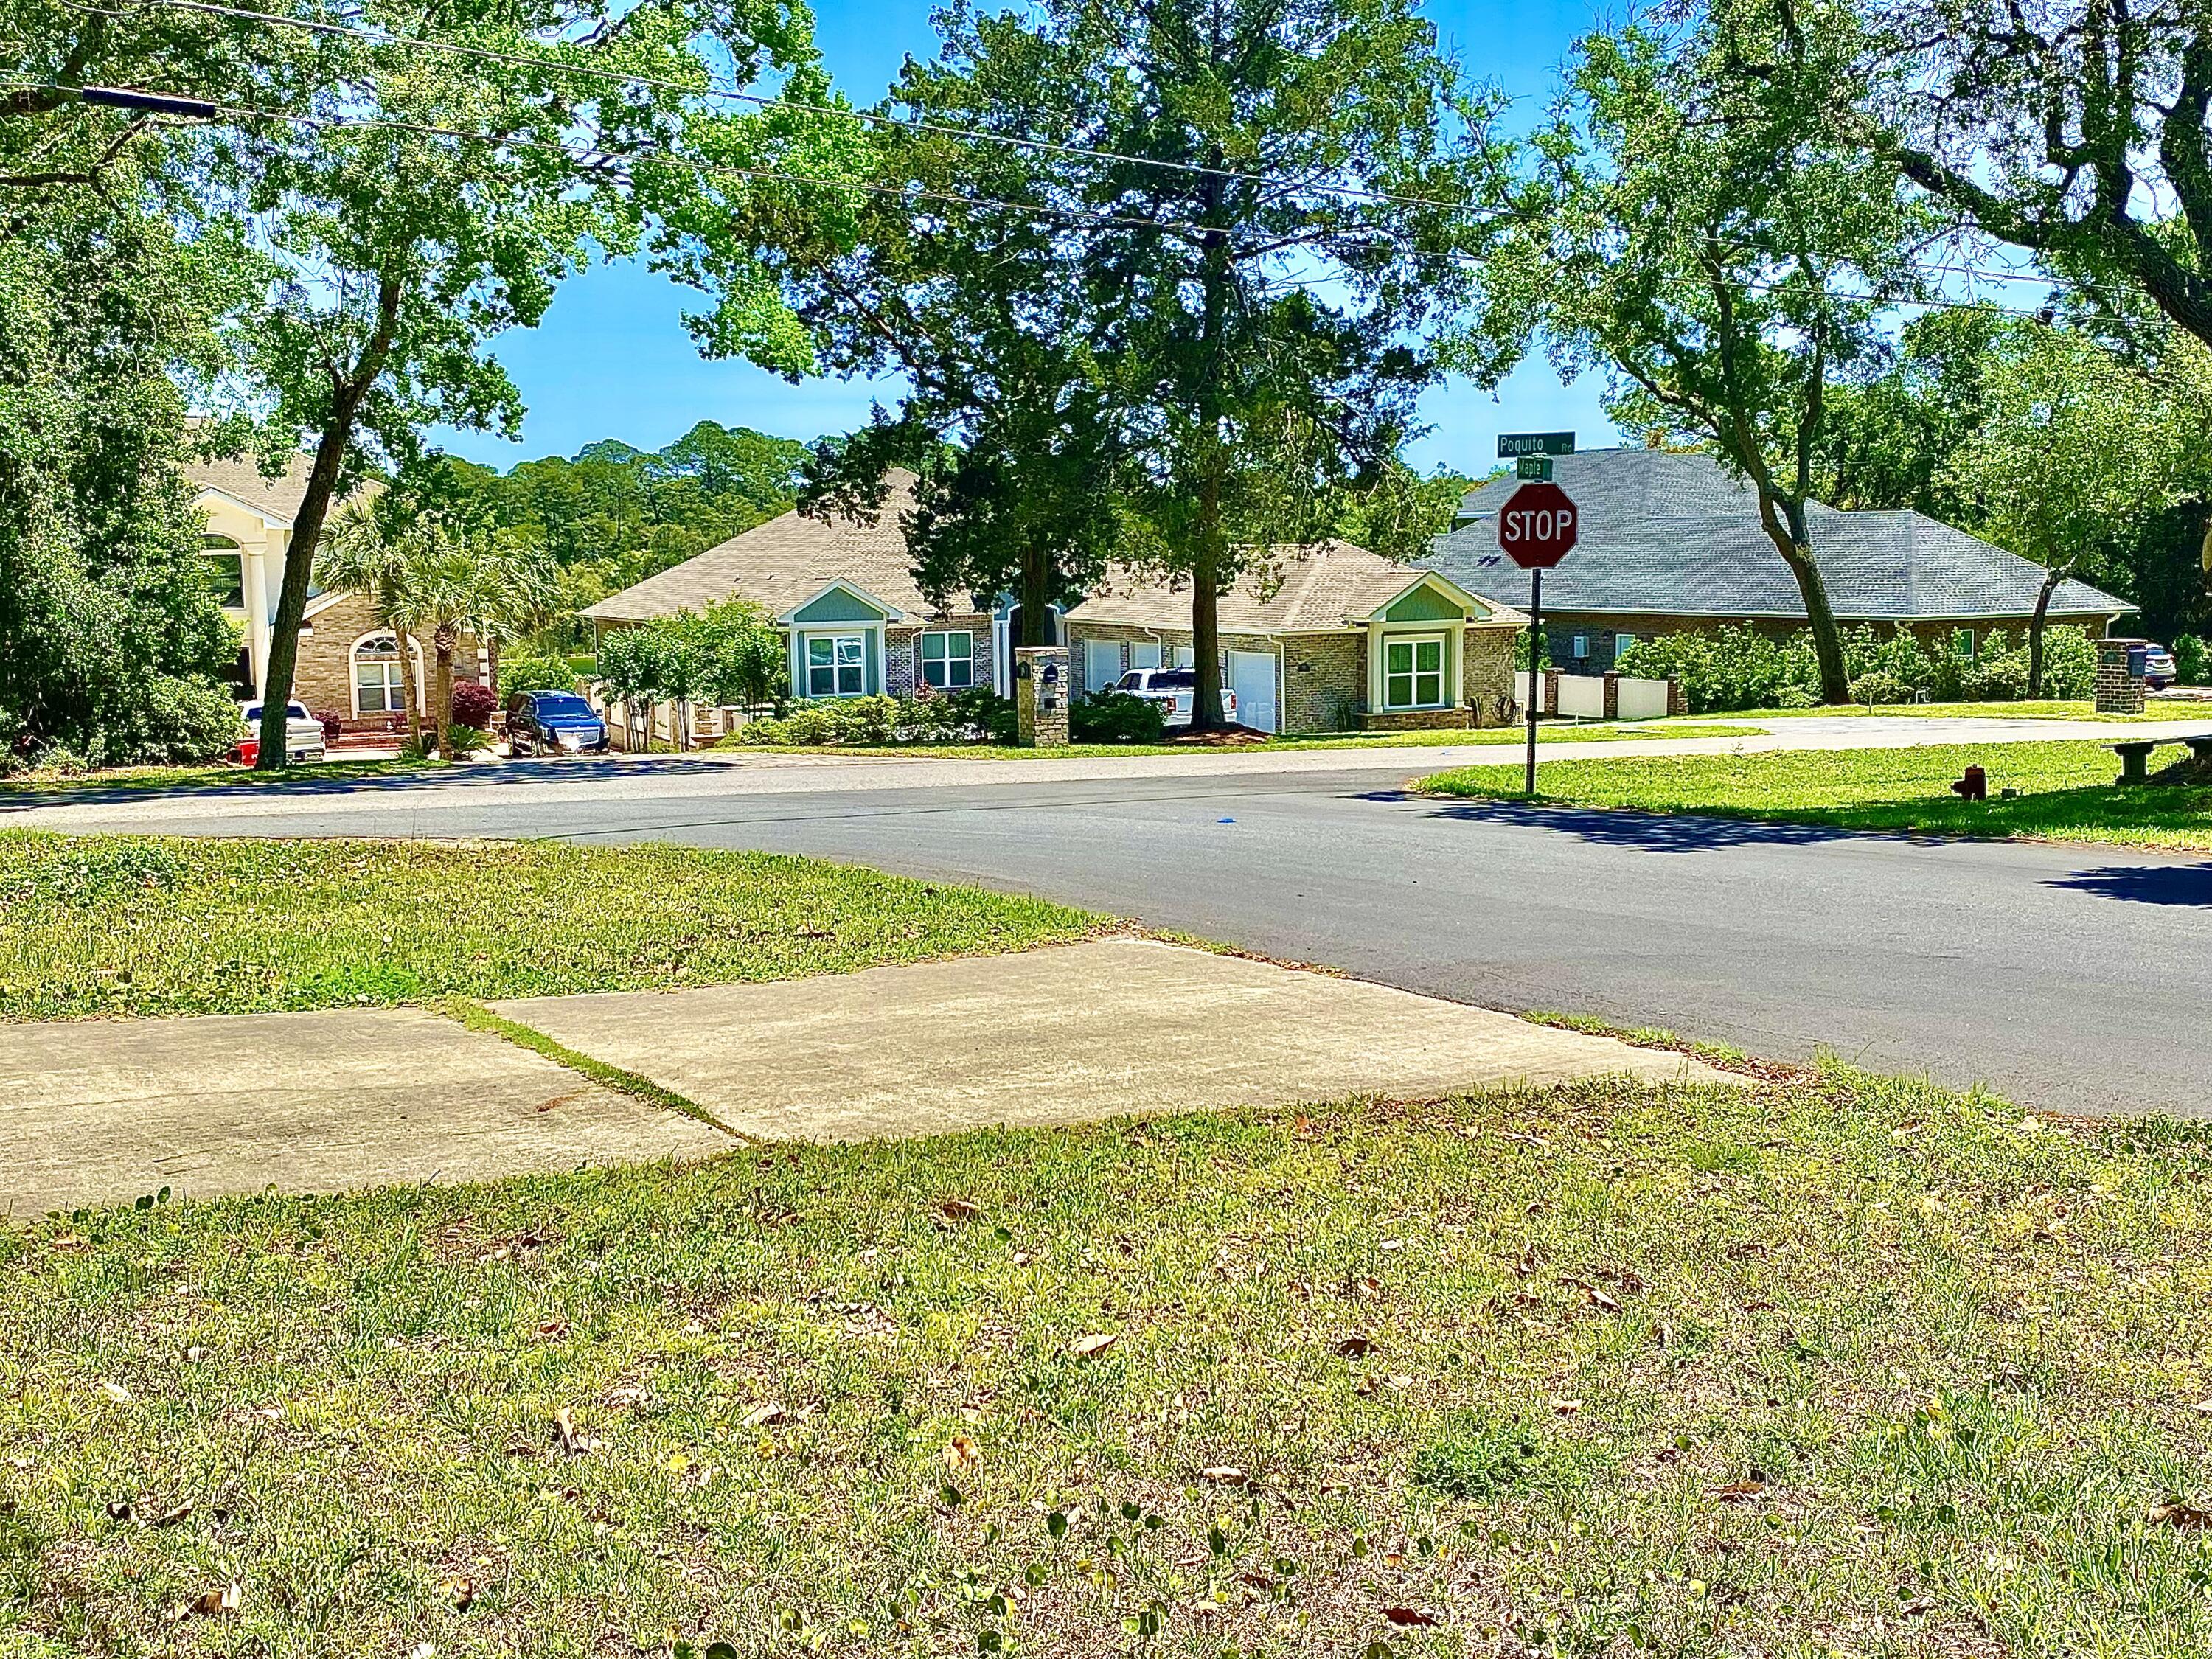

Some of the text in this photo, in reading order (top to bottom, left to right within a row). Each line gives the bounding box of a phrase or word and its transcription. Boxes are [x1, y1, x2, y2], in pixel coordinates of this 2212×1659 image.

[1500, 437, 1572, 453] Poquito Rd
[1518, 459, 1541, 477] Maple
[1505, 510, 1572, 541] STOP
